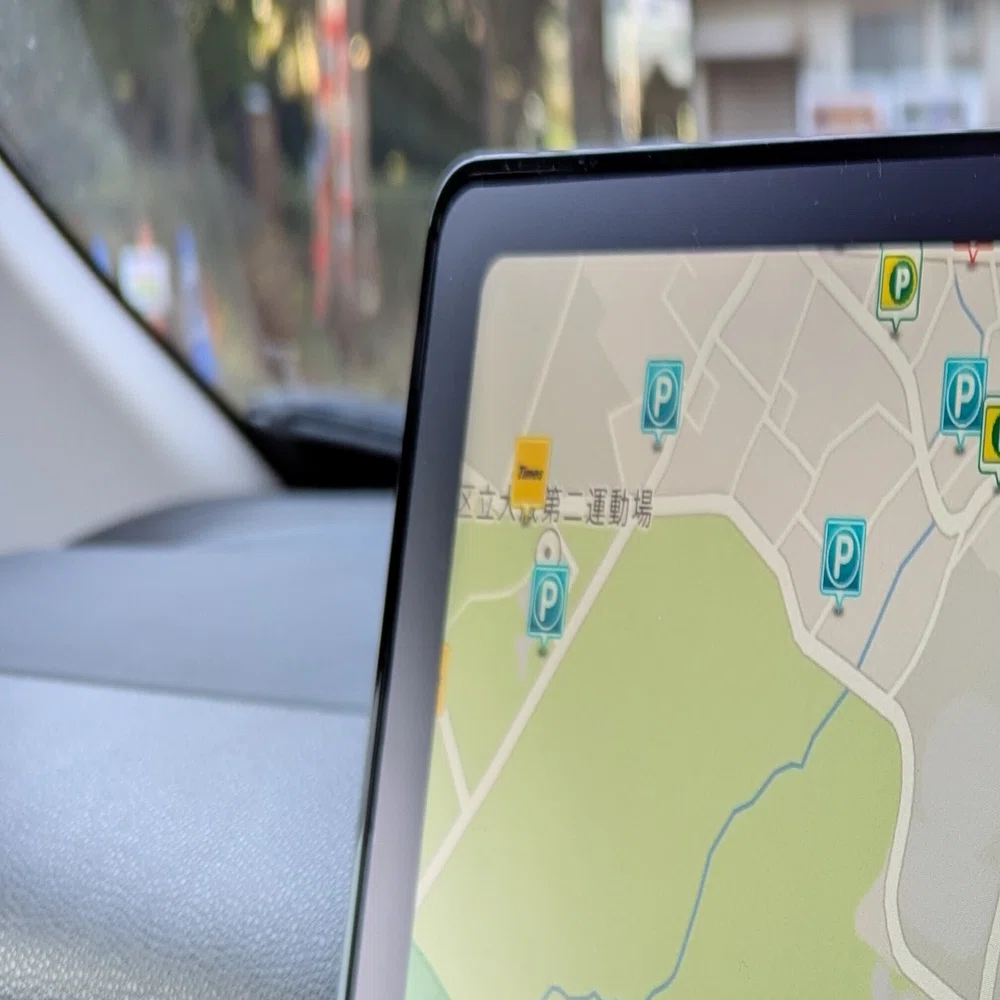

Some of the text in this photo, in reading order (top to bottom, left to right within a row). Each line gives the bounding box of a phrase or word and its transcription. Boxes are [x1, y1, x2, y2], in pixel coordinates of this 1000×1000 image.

[895, 267, 911, 301] P
[654, 375, 673, 418] P
[954, 372, 976, 419] P
[517, 464, 545, 481] Times
[459, 483, 654, 529] 区立大第二運動場
[833, 534, 854, 580] P
[540, 580, 558, 623] P
